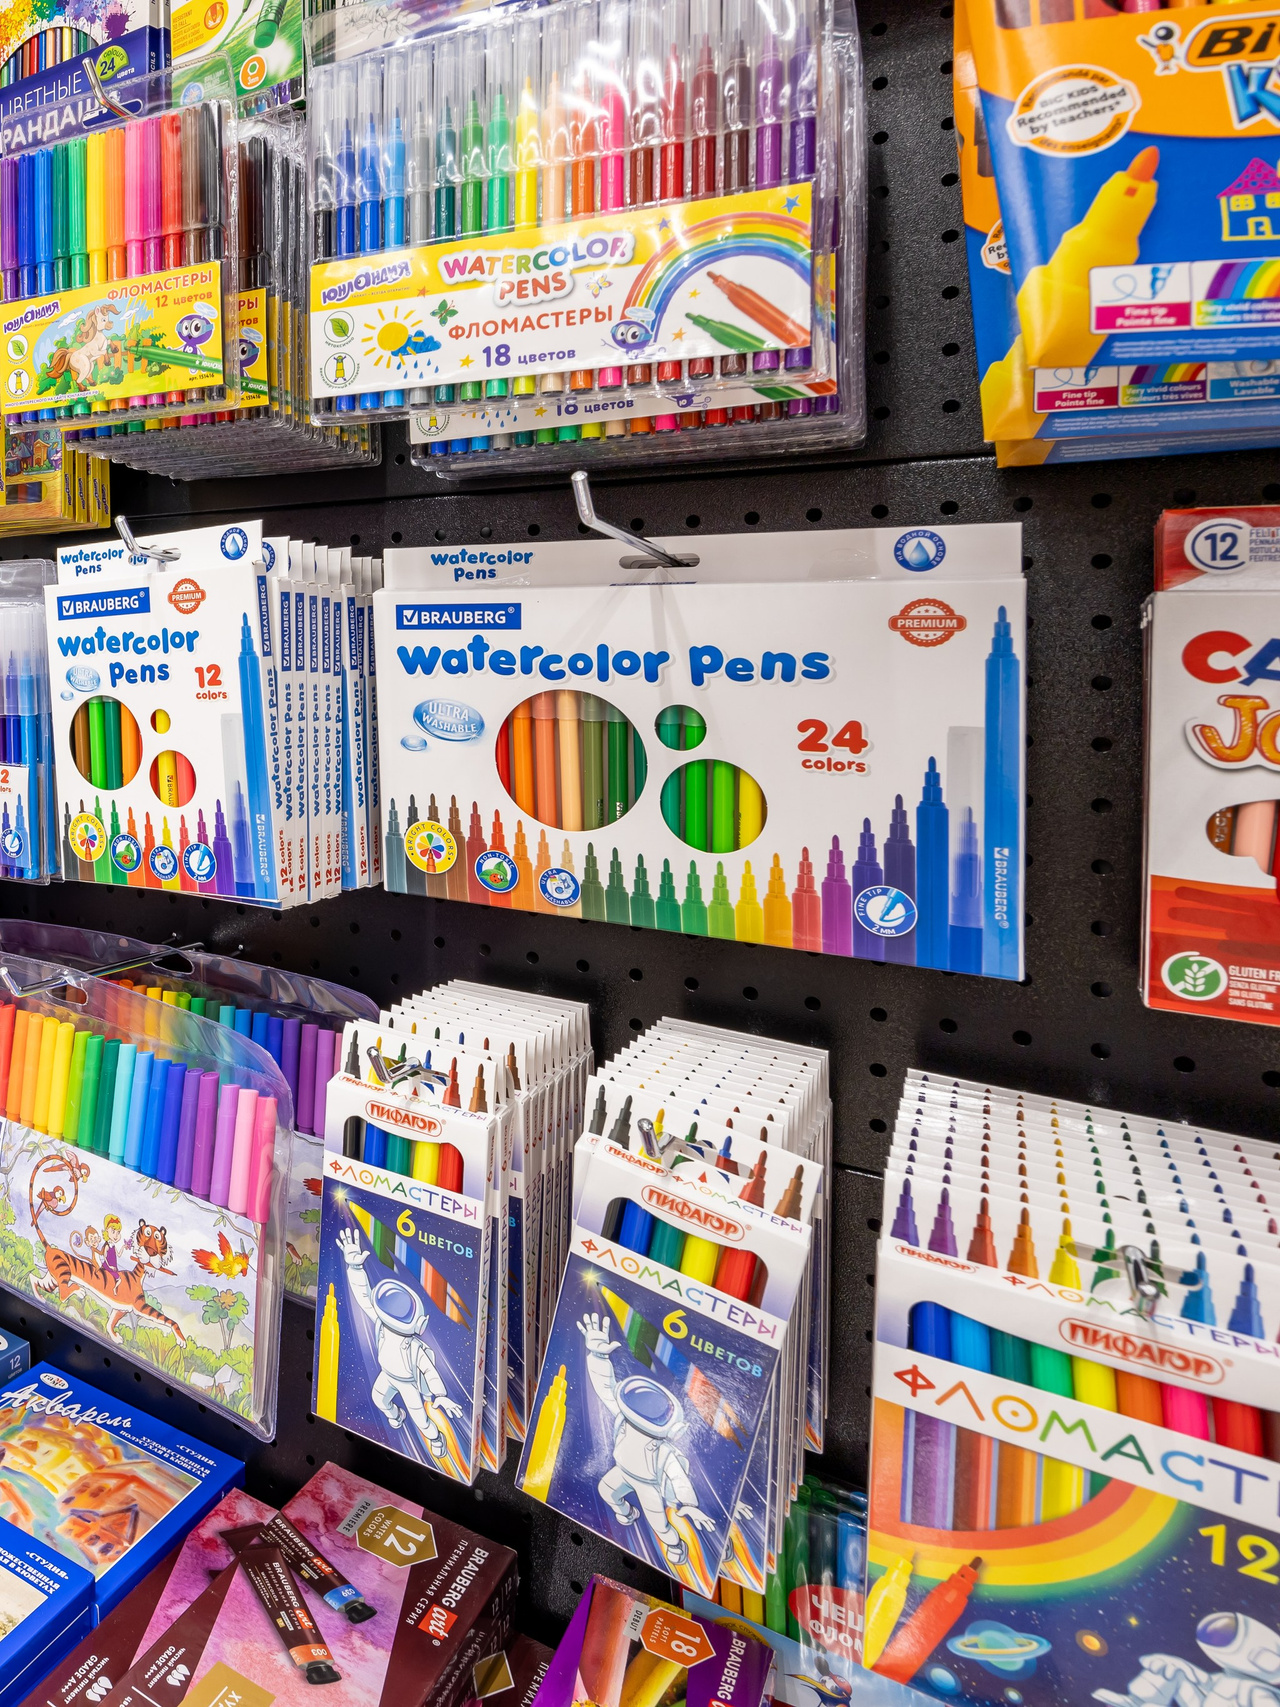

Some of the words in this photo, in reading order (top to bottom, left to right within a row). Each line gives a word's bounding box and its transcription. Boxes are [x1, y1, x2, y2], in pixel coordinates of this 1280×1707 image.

[100, 59, 116, 75] 24
[117, 67, 135, 79] цвета
[1, 71, 82, 123] ЦВЕТНЫЕ
[1017, 88, 1127, 127] Recommended
[1030, 123, 1047, 134] by
[444, 238, 627, 278] WATERCOLOR
[107, 270, 212, 300] ФЛОМАСТЕРЫ
[500, 271, 567, 300] PENS
[156, 294, 168, 308] 12
[173, 291, 212, 306] цветов
[448, 305, 613, 340] ФЛОМАСТЕРЫ
[483, 344, 511, 367] 18
[519, 350, 576, 364] цветов
[1083, 390, 1097, 399] tip
[1126, 387, 1147, 396] Very
[1148, 385, 1167, 393] vivid
[1230, 378, 1280, 387] Washable
[1234, 387, 1275, 396] Lavable
[1055, 399, 1084, 407] Pointe
[1124, 394, 1160, 403] Couleurs
[1162, 392, 1179, 400] très
[1204, 532, 1238, 561] 12
[1250, 529, 1270, 537] FELT
[61, 548, 124, 564] watercolor
[431, 549, 533, 566] watercolor
[76, 597, 139, 614] BRAUBERG
[172, 593, 202, 601] PREMIUM
[421, 610, 506, 624] BRAUBERG
[897, 619, 957, 628] PREMIUM
[58, 626, 199, 657] watercolor
[397, 634, 670, 682] watercolor
[195, 664, 222, 688] 12
[196, 690, 228, 700] colors
[422, 714, 477, 733] WASHABLE
[428, 702, 469, 721] ULTRA
[797, 719, 869, 754] 24
[802, 757, 866, 773] colors
[479, 853, 515, 869] NON-TOXIC
[1229, 966, 1266, 979] GLUTEN
[1269, 970, 1280, 981] FR
[370, 1103, 437, 1133] ПИФАГОР
[329, 1160, 477, 1220] ФЛОМАСТЕРЫ
[646, 1189, 740, 1236] ПИФАГОР
[396, 1209, 415, 1237] 6
[418, 1231, 473, 1259] ЦВЕТОВ
[581, 1239, 777, 1339] ФЛОМАСТЕРЫ
[662, 1309, 688, 1339] 6
[690, 1339, 762, 1378] ЦВЕТОВ
[1069, 1322, 1214, 1378] ПИФАГОР
[119, 1429, 164, 1455] ПОЛУСУХАЯ
[168, 1456, 208, 1478] КЮВЕТАХ
[894, 1364, 1280, 1518] ФЛОМАСТ
[142, 1435, 210, 1475] ХУДОЖЕСТВЕННАЯ
[343, 1501, 371, 1533] PREMIERE
[364, 1513, 385, 1537] COLORS
[373, 1519, 392, 1540] WATER
[383, 1525, 427, 1556] 12
[426, 1540, 468, 1596] ПРЕМИАЛЬНАЯ
[1199, 1524, 1280, 1585] 12
[14, 1563, 57, 1595] КЮВЕТАХ
[442, 1548, 489, 1608] BRAUBERG
[405, 1598, 429, 1625] СЕРИЯ
[428, 1607, 449, 1640] art
[630, 1611, 643, 1632] DEBUT
[649, 1618, 664, 1644] PASTELS
[670, 1630, 701, 1658] 18
[717, 1638, 746, 1700] BRAUBERG
